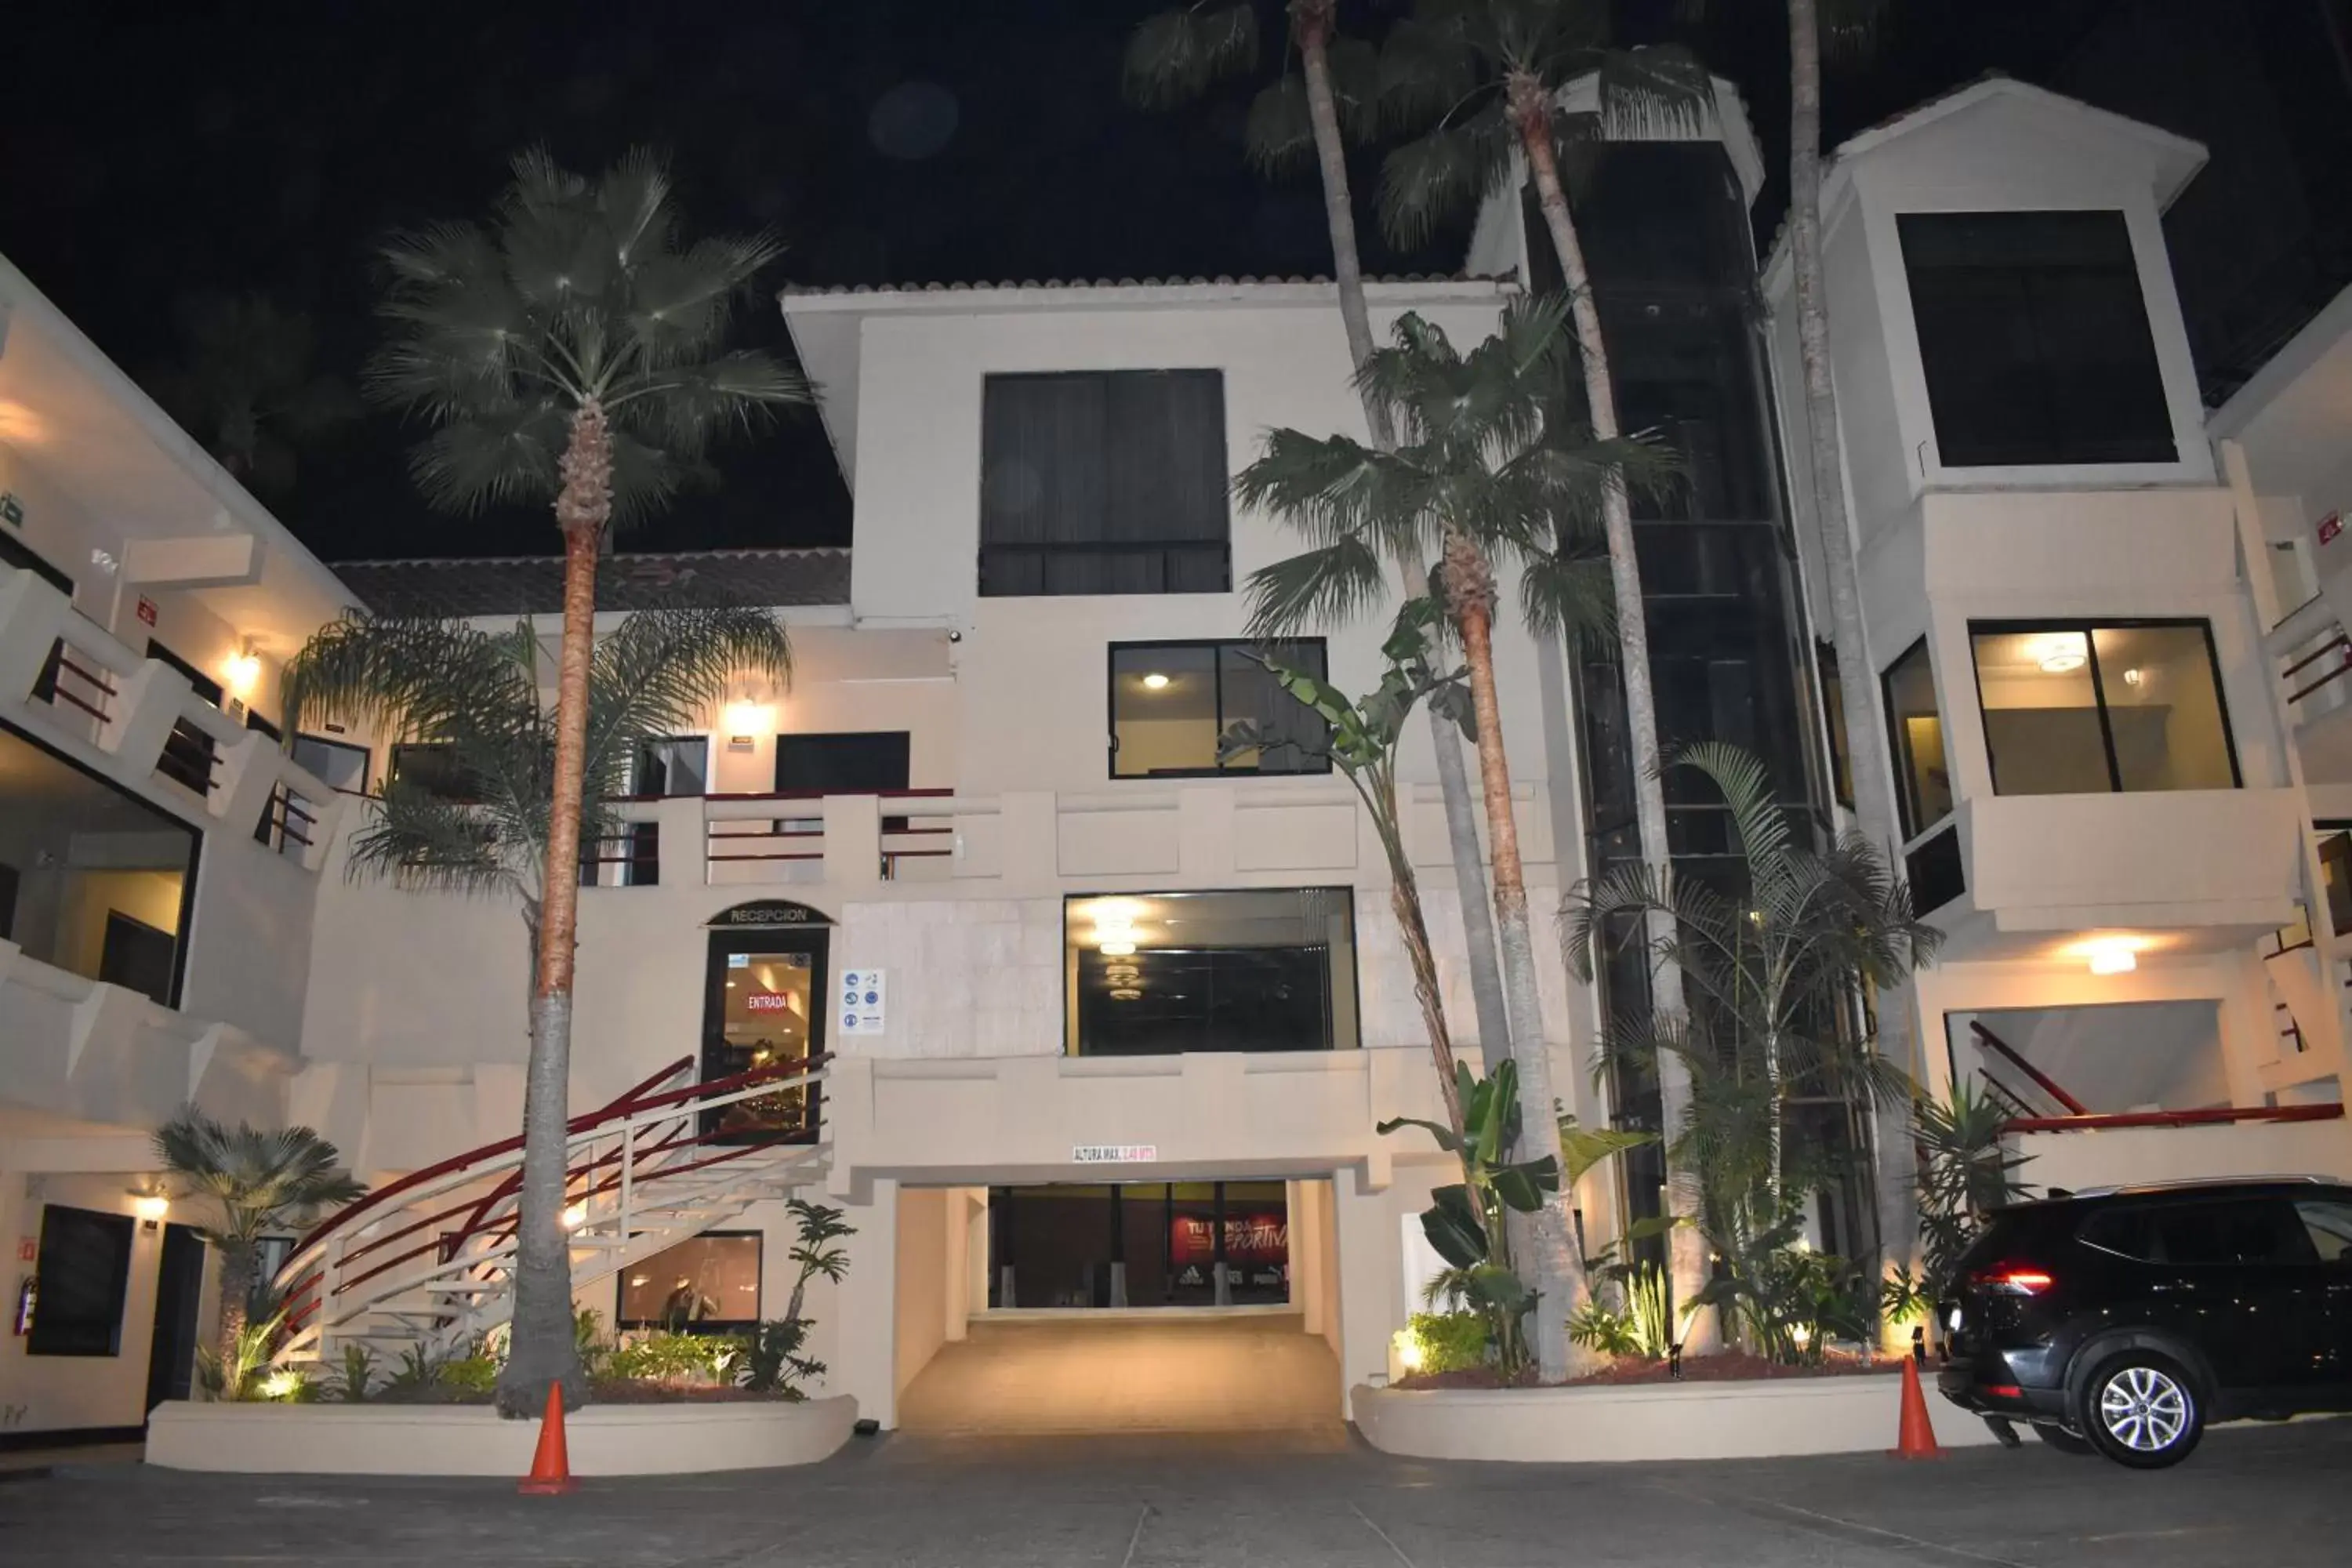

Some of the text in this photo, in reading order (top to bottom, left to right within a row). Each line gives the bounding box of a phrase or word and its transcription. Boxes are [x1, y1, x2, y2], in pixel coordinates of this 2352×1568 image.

[749, 995, 786, 1010] ENTRADA
[1073, 1147, 1102, 1161] ALTURA
[1188, 1220, 1252, 1235] TU TNDA
